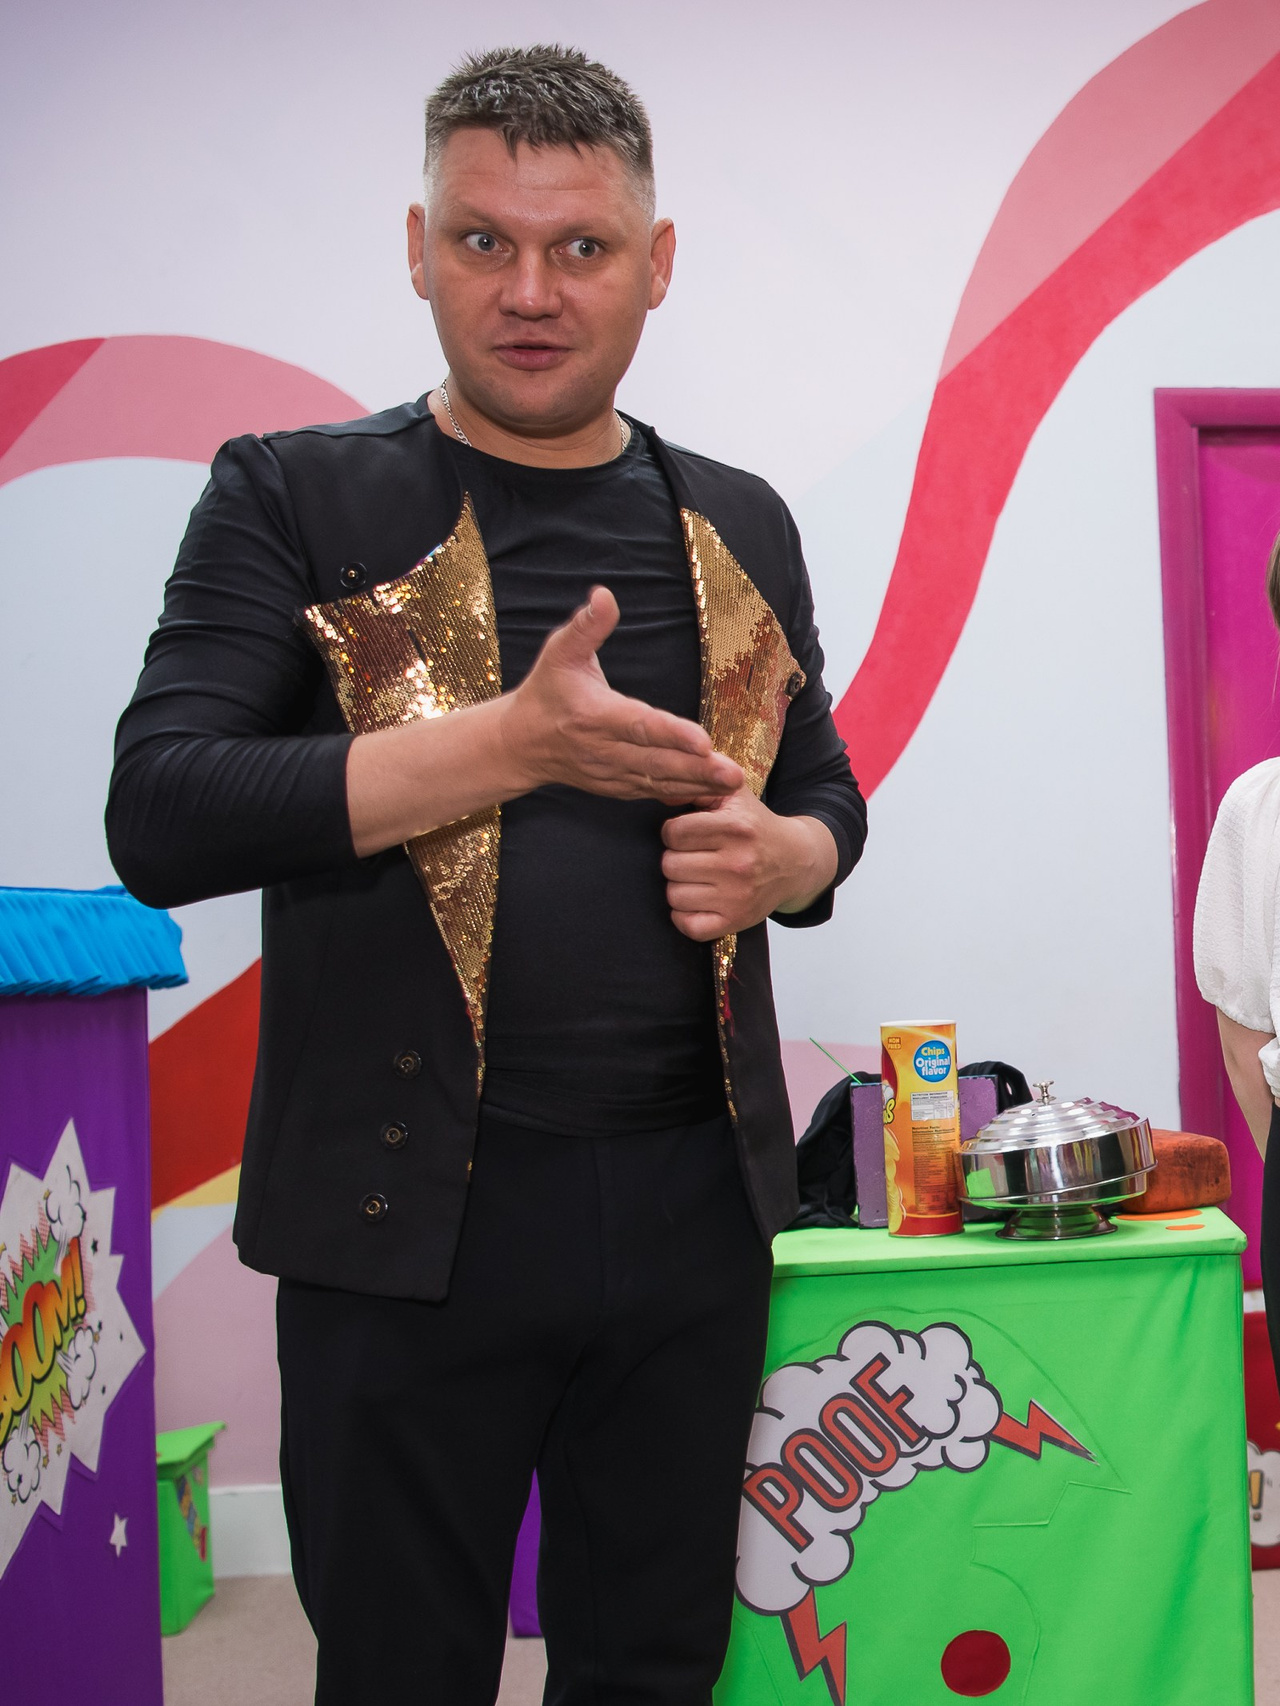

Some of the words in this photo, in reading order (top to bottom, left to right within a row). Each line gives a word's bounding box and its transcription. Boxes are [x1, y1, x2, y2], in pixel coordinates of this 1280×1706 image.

[921, 1047, 945, 1056] Chips
[915, 1056, 950, 1068] Original
[921, 1066, 946, 1076] flavor
[742, 1352, 928, 1554] POOF
